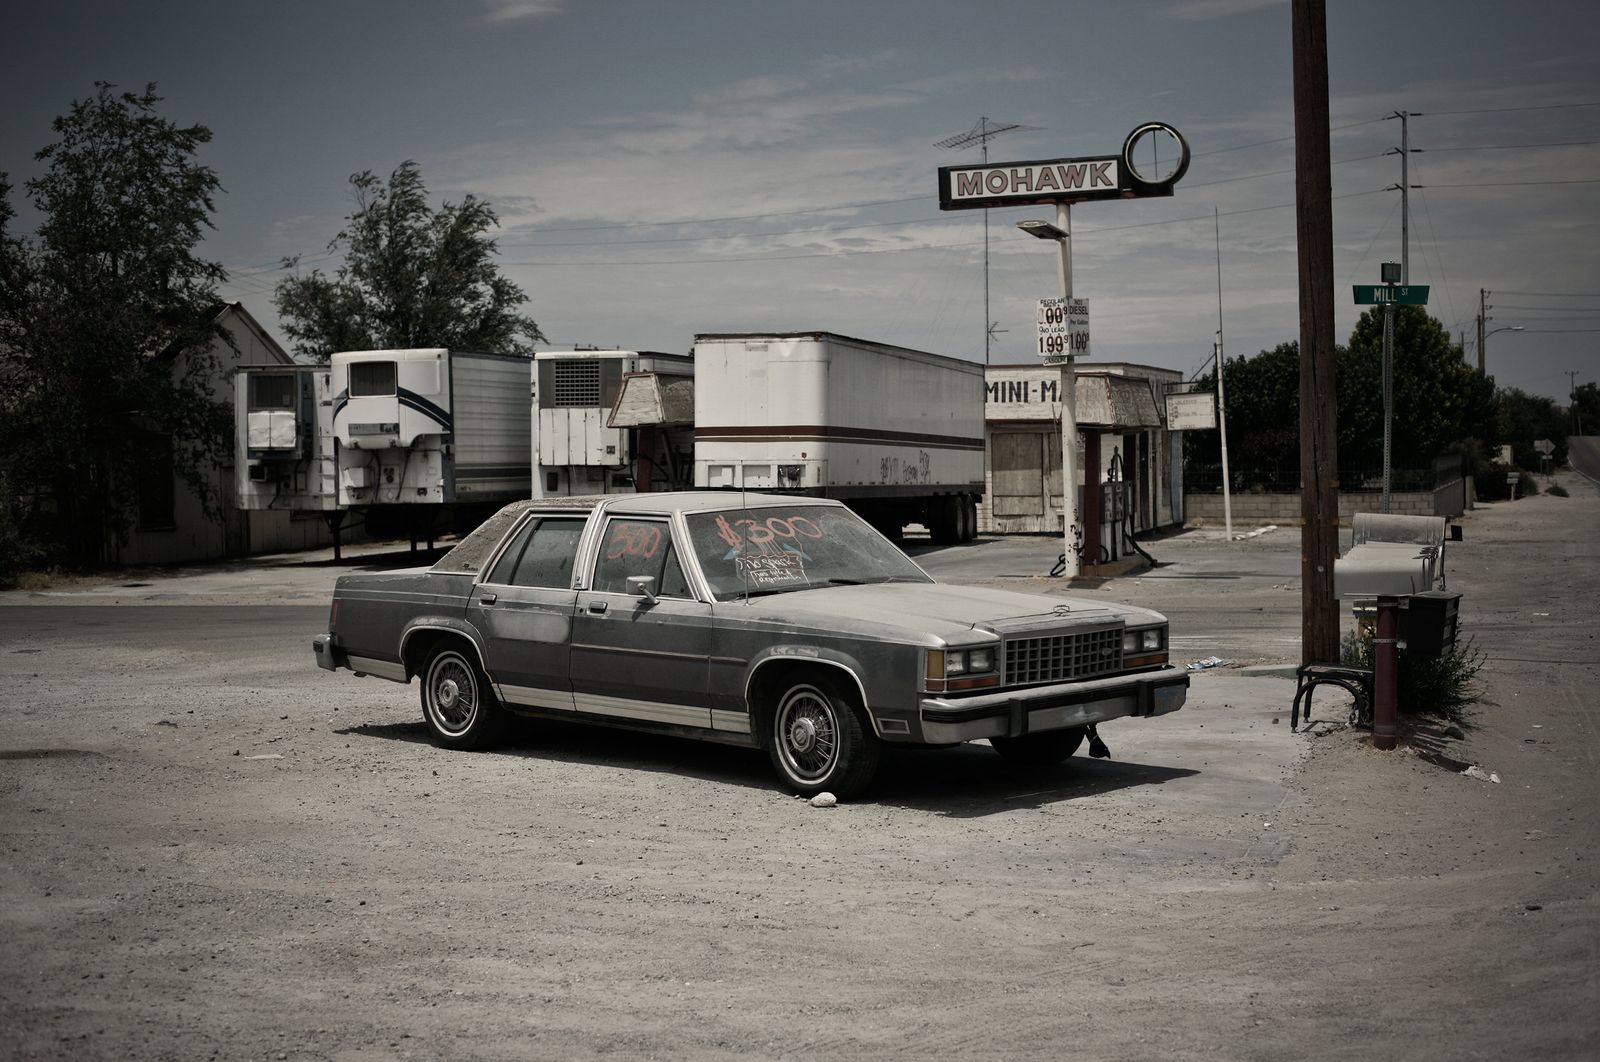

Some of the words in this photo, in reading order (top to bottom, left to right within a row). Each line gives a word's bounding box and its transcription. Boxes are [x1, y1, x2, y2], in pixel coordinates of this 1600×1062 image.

[957, 162, 1114, 197] MOHAWK
[1373, 288, 1398, 302] MILL
[1401, 288, 1408, 296] ST
[1069, 305, 1089, 315] DIESEL
[985, 380, 1061, 403] MINI-M
[715, 514, 823, 551] $300
